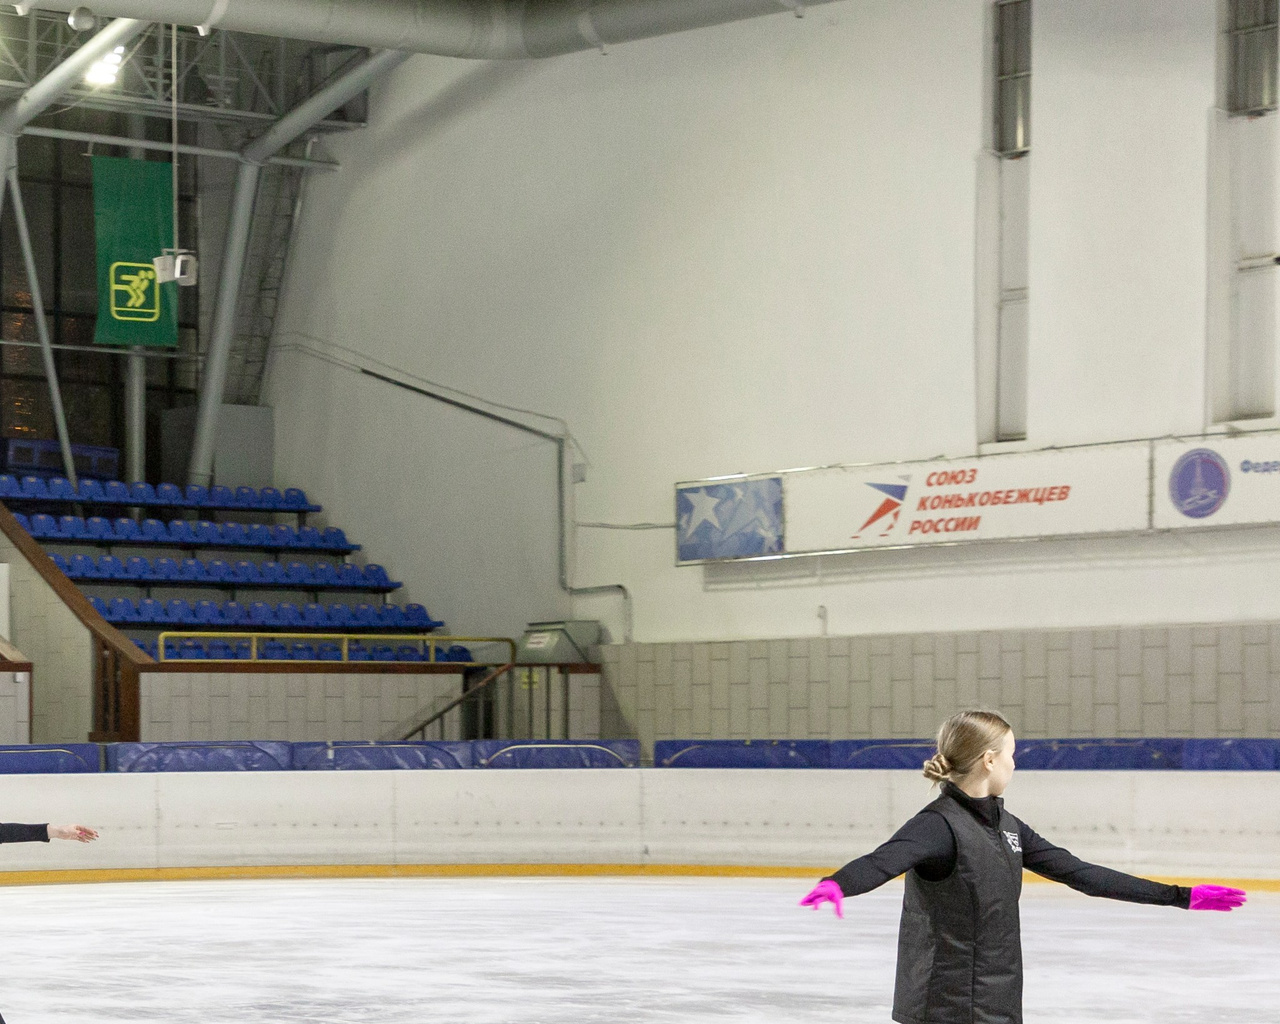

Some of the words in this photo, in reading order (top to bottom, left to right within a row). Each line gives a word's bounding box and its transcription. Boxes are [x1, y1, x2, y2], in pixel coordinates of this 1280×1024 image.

[926, 468, 978, 487] СОЮЗ
[916, 485, 1072, 512] КОНЬКОБЕЖЦЕВ
[908, 515, 982, 535] РОССИИ
